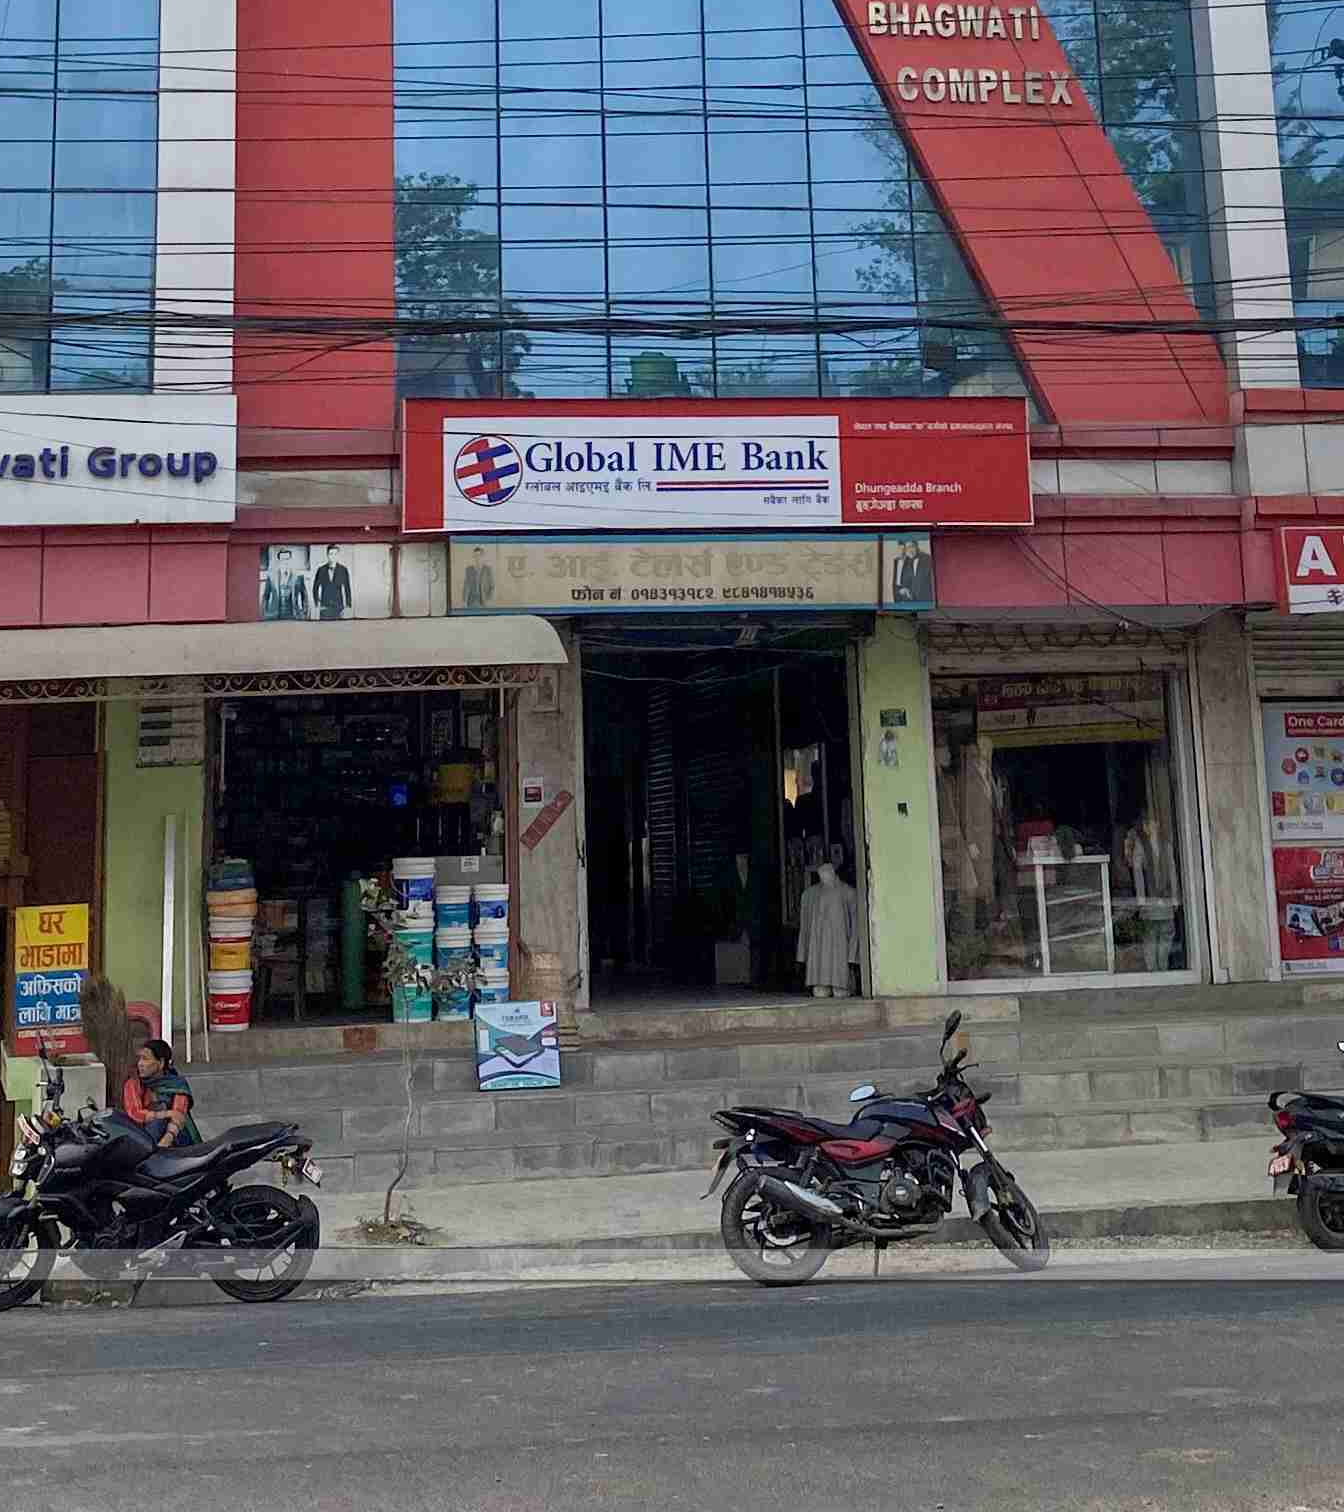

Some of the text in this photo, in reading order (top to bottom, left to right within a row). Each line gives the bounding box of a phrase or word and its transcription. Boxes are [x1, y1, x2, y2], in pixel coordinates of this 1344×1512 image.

[867, 0, 1040, 40] BHAGWATI
[896, 66, 1073, 105] COMPLEX
[88, 445, 218, 484] Group
[525, 440, 829, 472] Global IME Bank
[925, 482, 962, 494] Branch
[570, 585, 605, 601] फोन
[1288, 716, 1314, 728] One
[39, 911, 67, 935] घर
[19, 943, 85, 969] भाडामा
[19, 972, 82, 997] अफिसको
[18, 1002, 82, 1025] लागि मात्र
